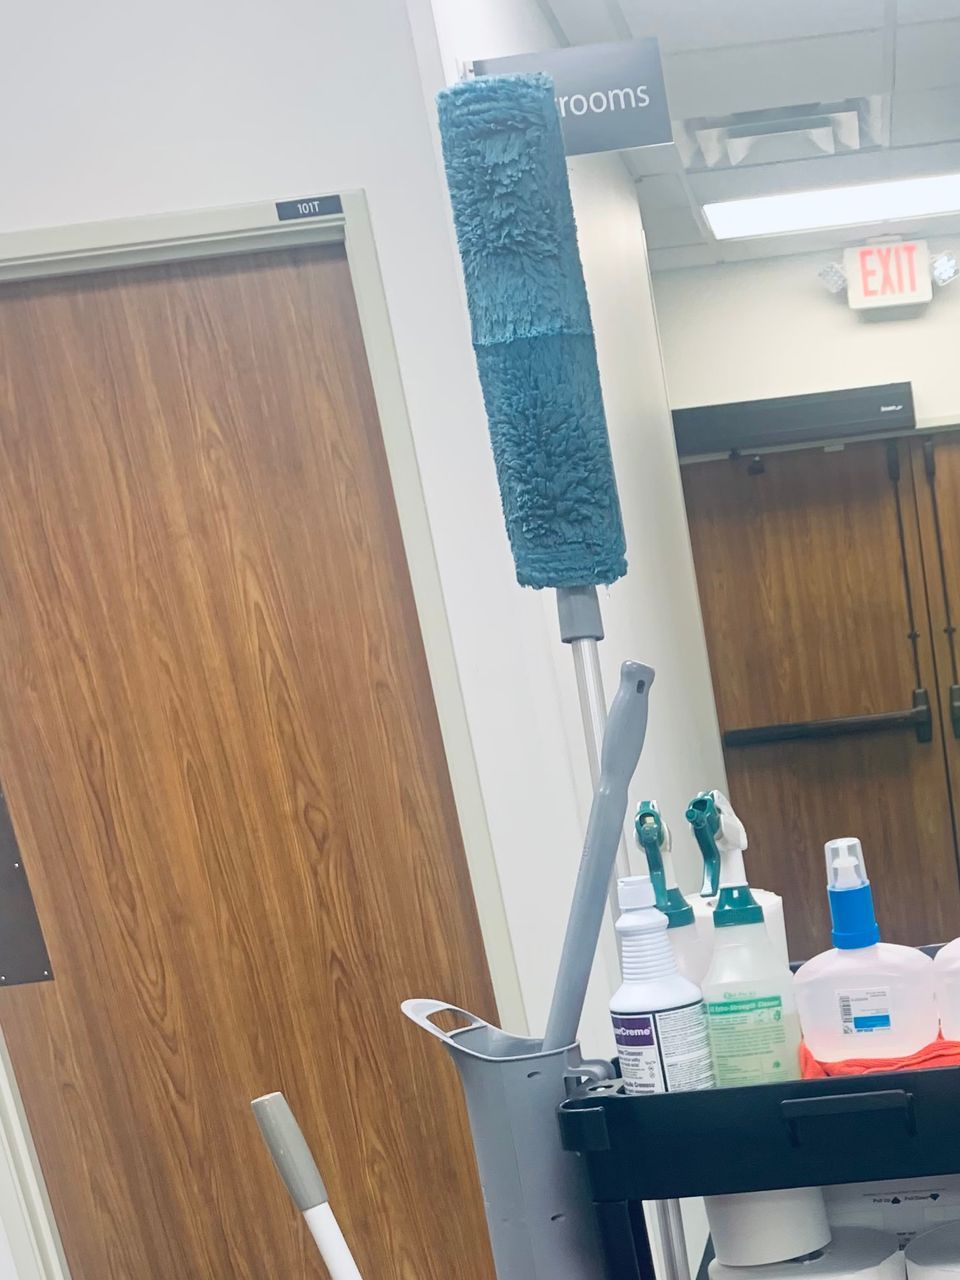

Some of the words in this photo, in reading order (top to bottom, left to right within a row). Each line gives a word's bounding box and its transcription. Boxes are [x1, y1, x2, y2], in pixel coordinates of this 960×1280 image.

[556, 85, 650, 117] rooms
[297, 201, 320, 214] 101T
[858, 244, 917, 297] EXIT
